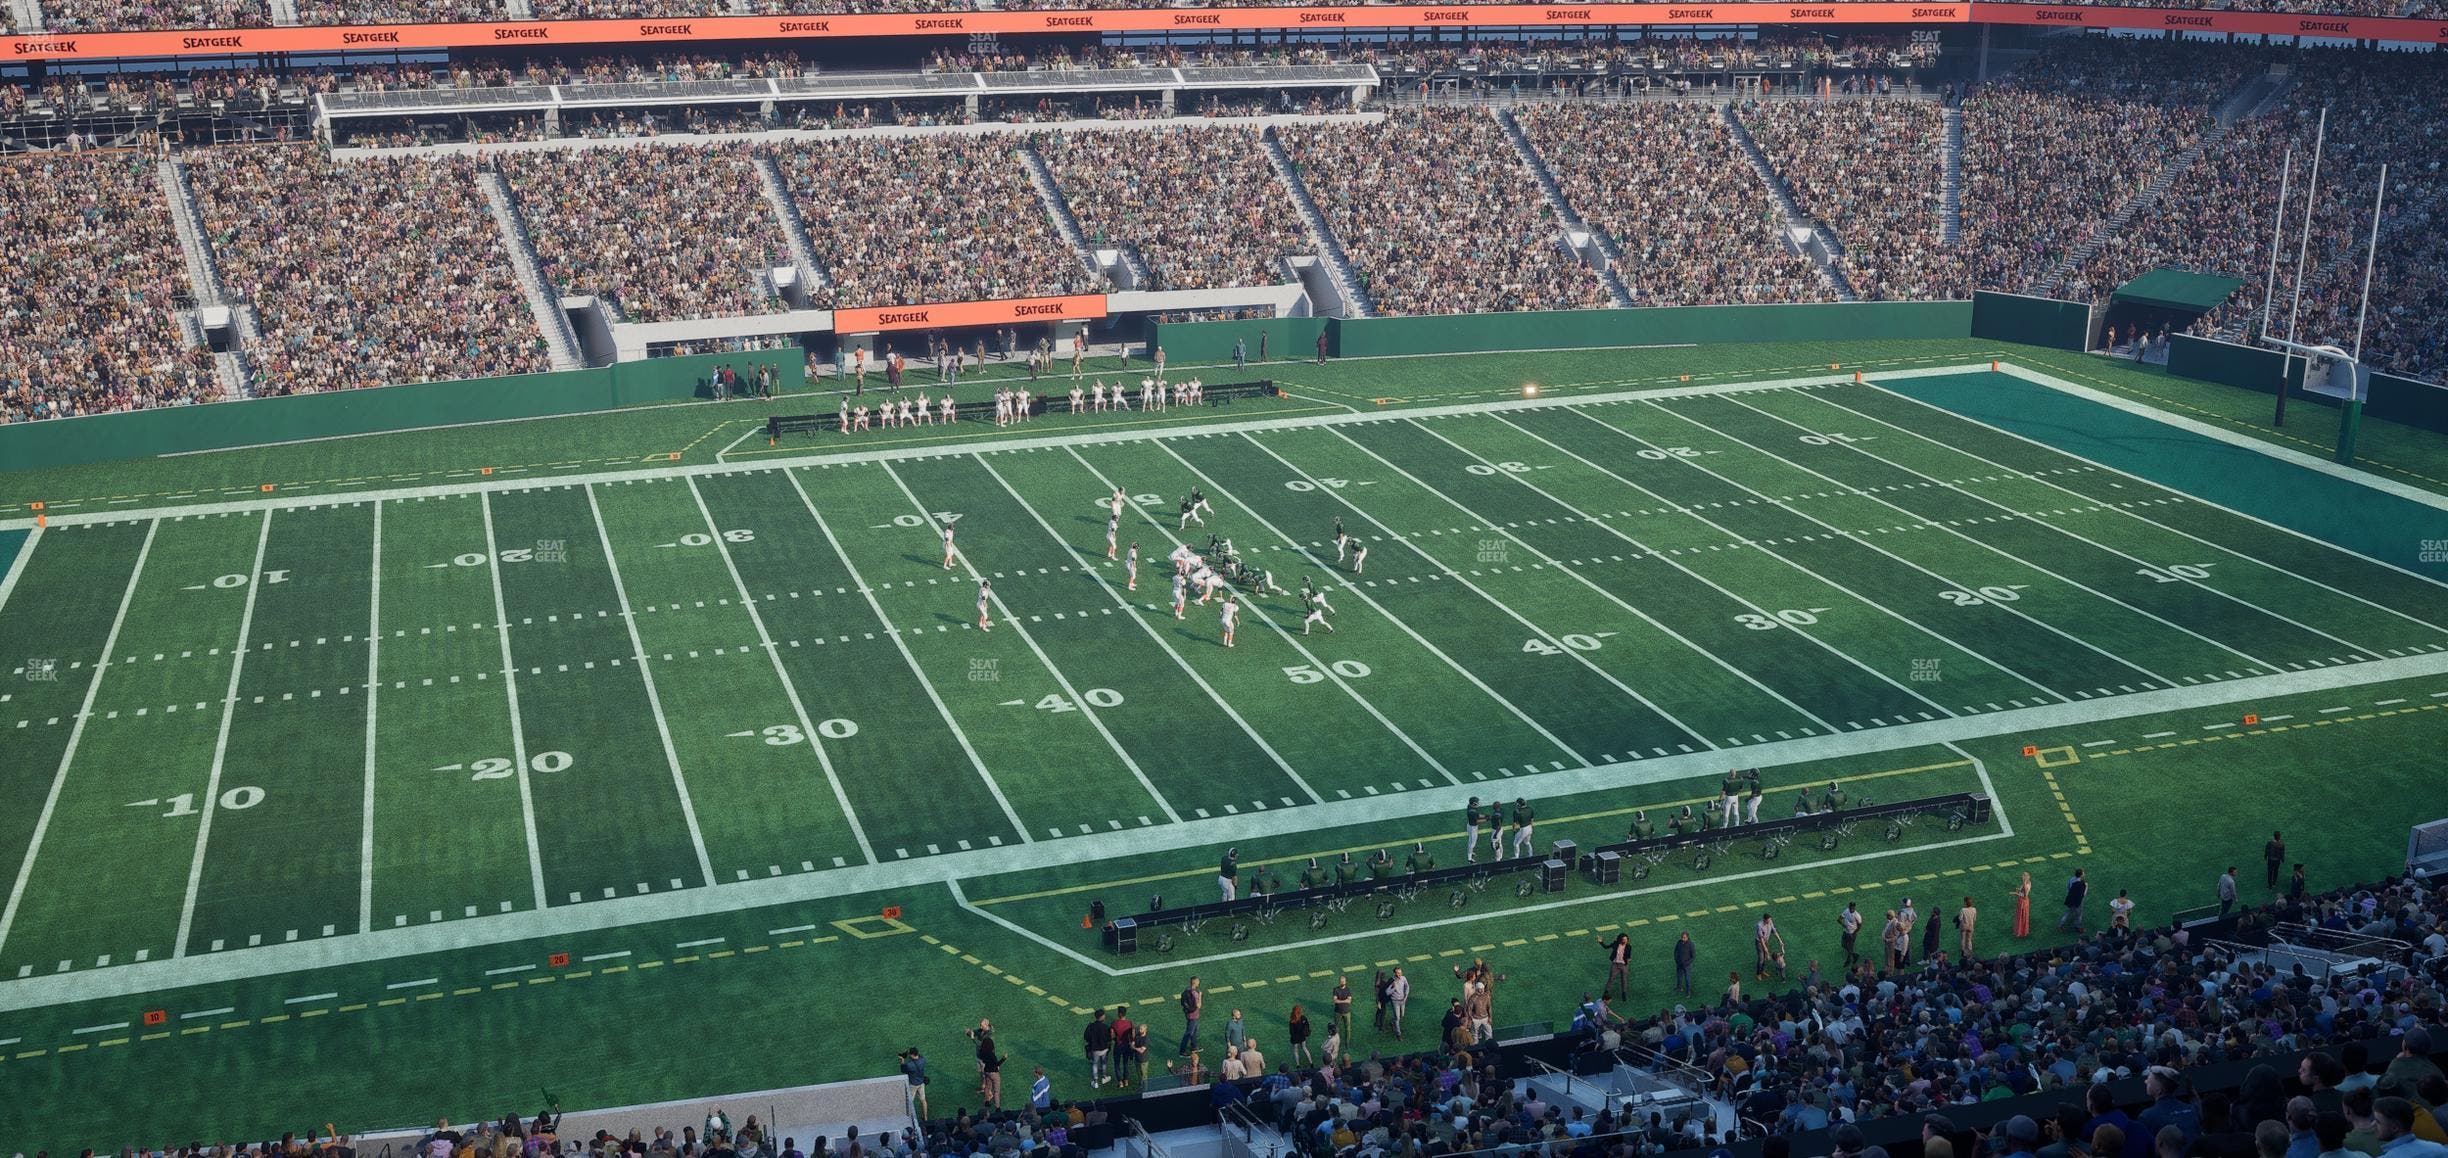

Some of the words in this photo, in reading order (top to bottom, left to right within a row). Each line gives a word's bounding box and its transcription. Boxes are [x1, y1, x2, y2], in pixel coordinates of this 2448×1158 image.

[879, 311, 928, 325] SEATGEEK
[1015, 303, 1063, 316] SEATGEEK
[1938, 586, 2020, 607] 20
[1734, 608, 1818, 630] 30
[1521, 633, 1602, 656] 40
[1281, 660, 1371, 684] 50
[1034, 688, 1125, 713] 40
[762, 718, 859, 746] 30
[470, 751, 573, 781] 20
[162, 786, 265, 818] 10
[886, 908, 897, 916] 30
[554, 956, 565, 964] 20
[150, 1013, 160, 1022] 10
